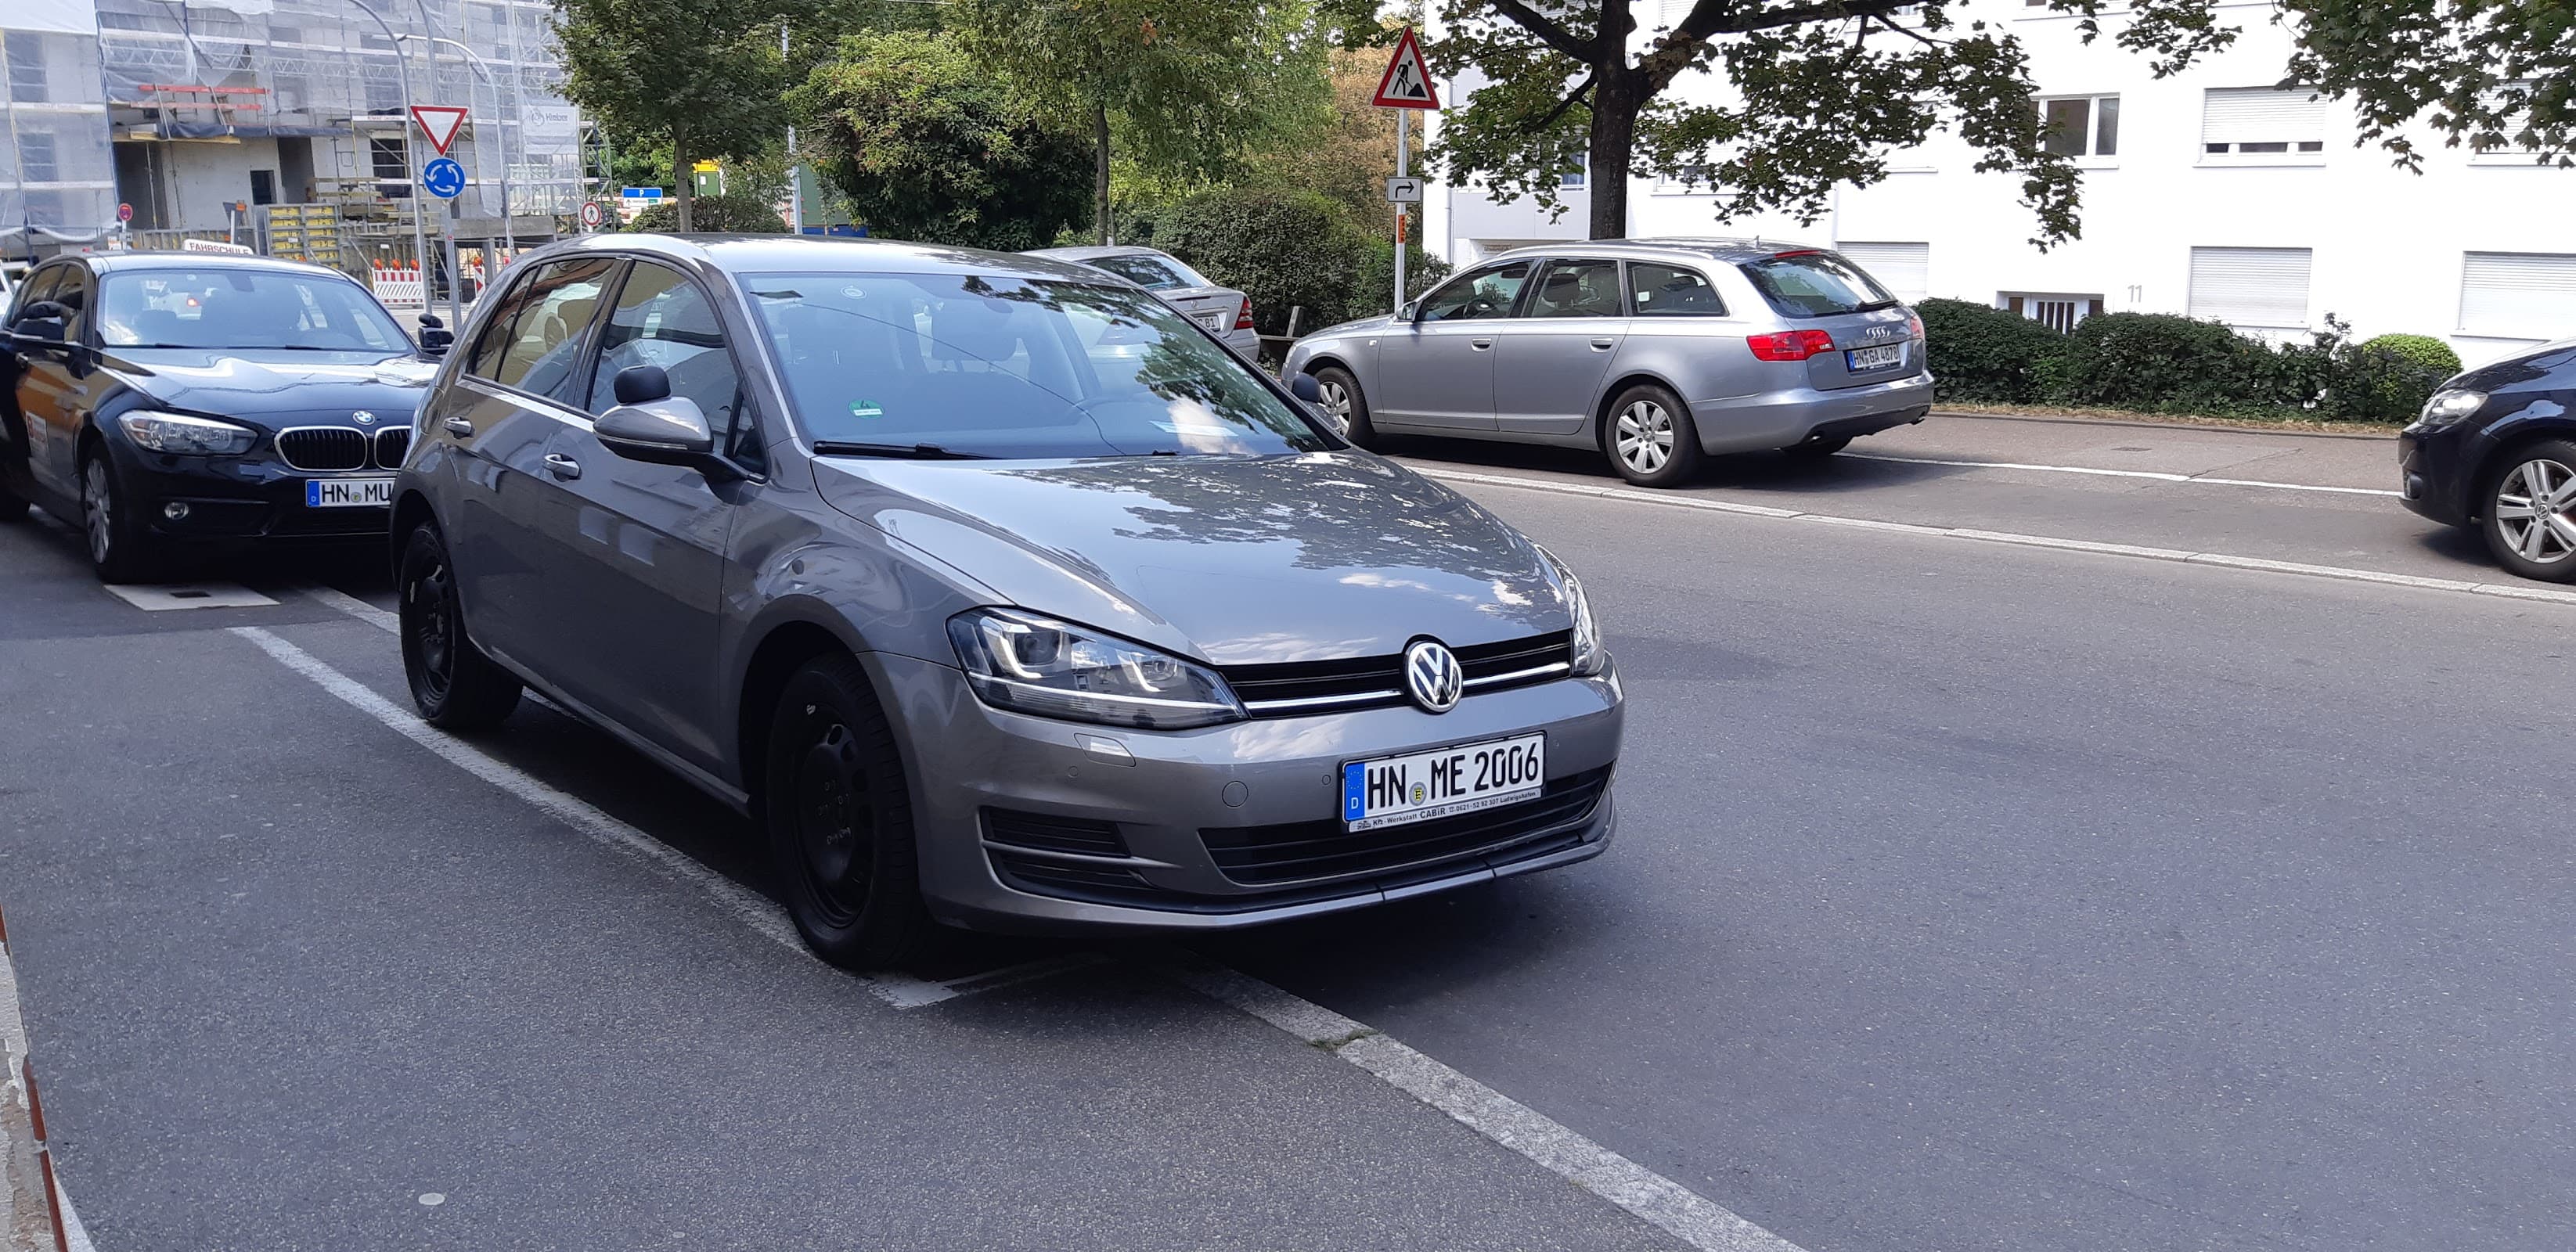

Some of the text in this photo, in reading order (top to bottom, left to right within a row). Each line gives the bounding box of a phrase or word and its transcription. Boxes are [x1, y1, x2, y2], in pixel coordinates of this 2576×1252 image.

[639, 189, 644, 197] P
[189, 243, 250, 255] FAHRSCHULE
[2127, 285, 2142, 303] 11
[1853, 350, 1864, 365] HN
[1868, 348, 1880, 363] GA
[322, 484, 350, 502] HN
[1350, 742, 1538, 810] D HN ME 2006
[1500, 791, 1536, 803] Ludwigshafen
